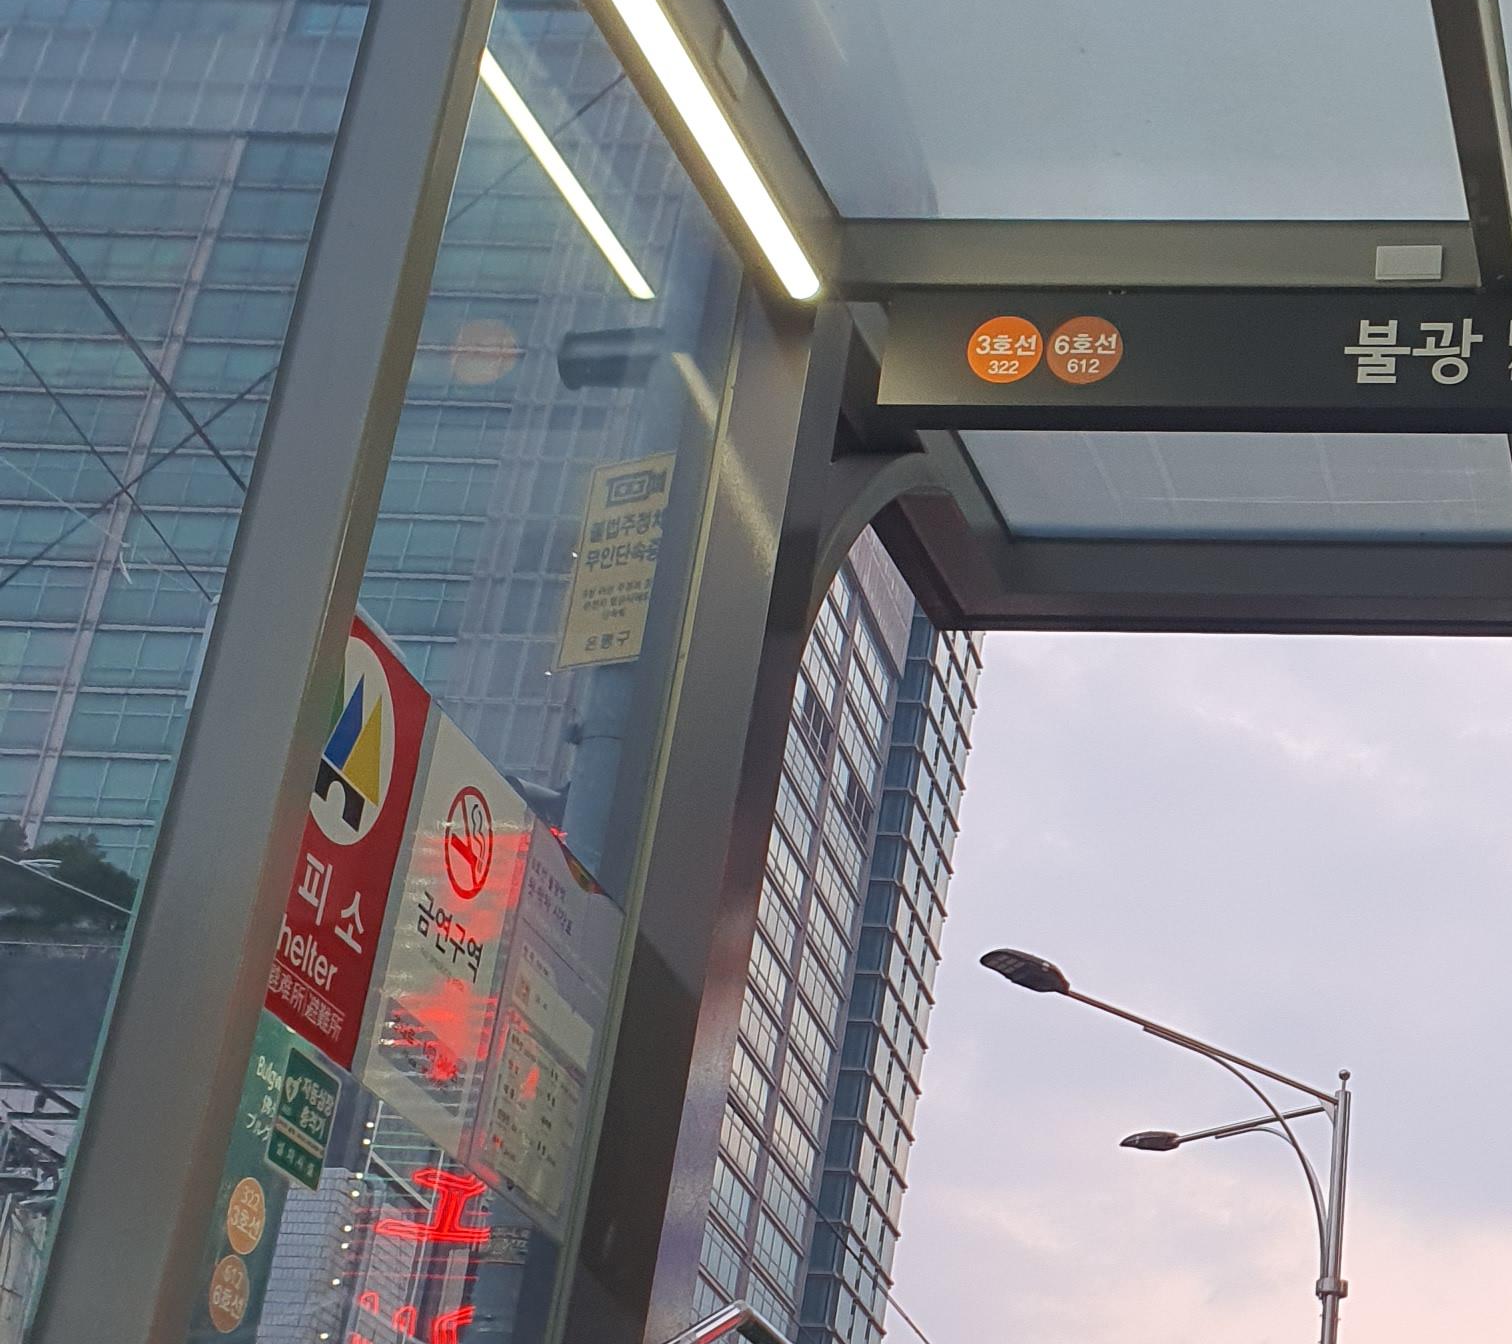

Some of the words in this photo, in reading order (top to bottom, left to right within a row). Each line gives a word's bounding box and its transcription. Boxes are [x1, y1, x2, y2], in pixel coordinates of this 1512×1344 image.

[975, 335, 1037, 356] 3호선
[1054, 333, 1118, 355] 6호선
[1344, 318, 1483, 385] 불광
[987, 360, 1019, 375] 322
[1067, 359, 1100, 373] 612
[417, 891, 483, 983] 금연구역
